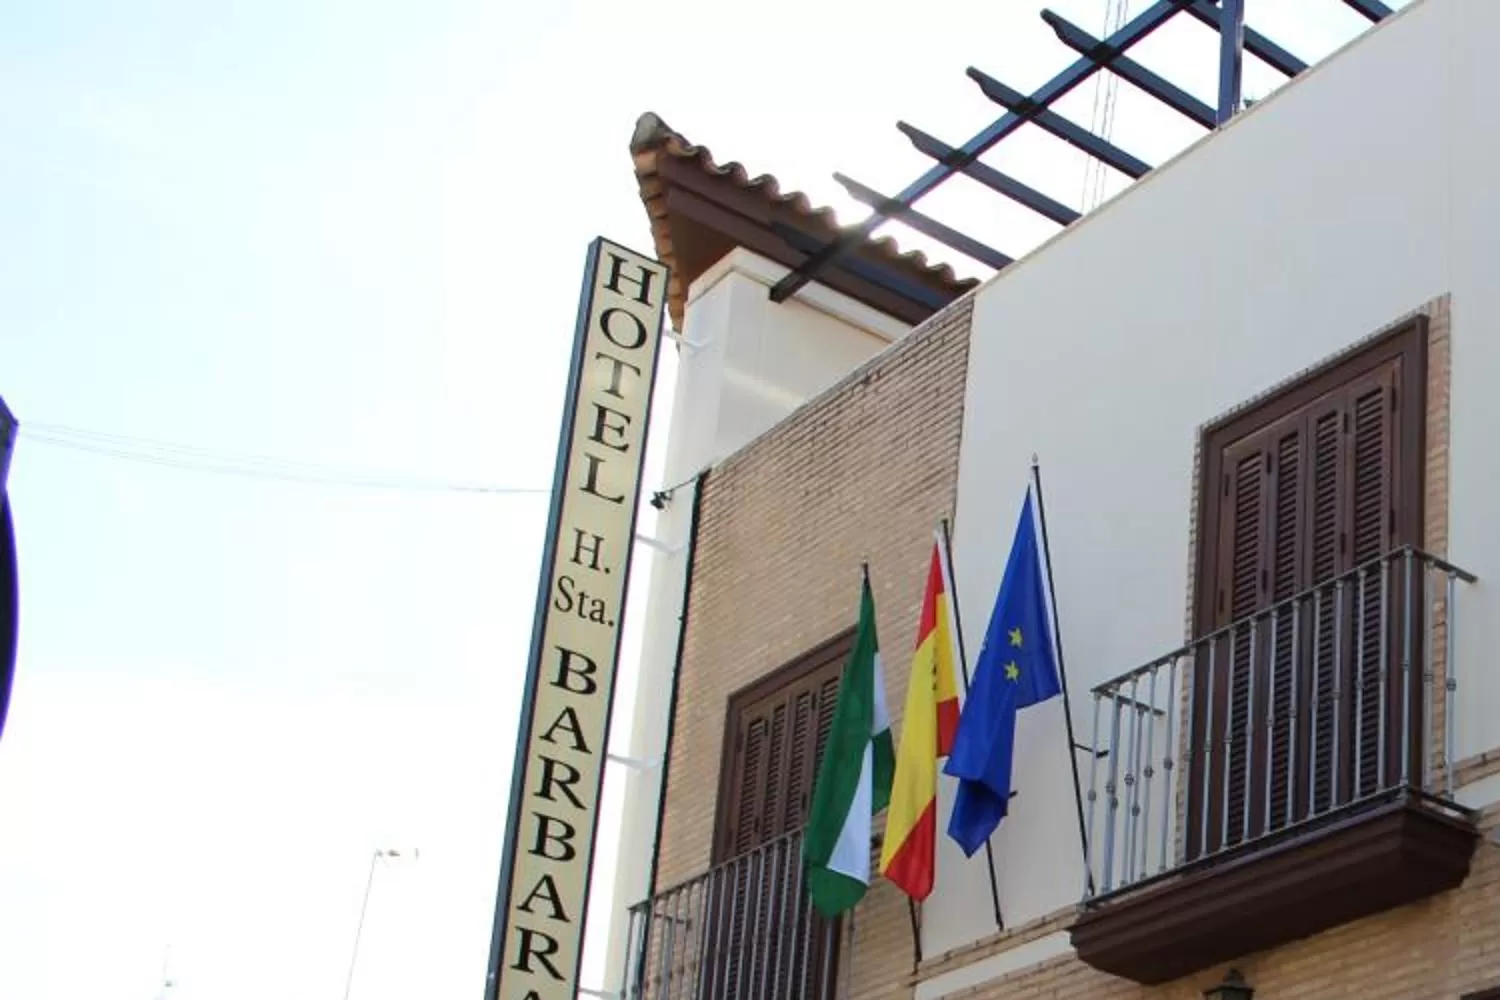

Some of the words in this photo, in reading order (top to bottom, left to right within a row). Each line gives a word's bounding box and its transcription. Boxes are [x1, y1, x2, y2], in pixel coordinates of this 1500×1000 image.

[579, 253, 659, 505] HOTEL
[569, 527, 612, 574] H.
[553, 576, 615, 627] Sta.
